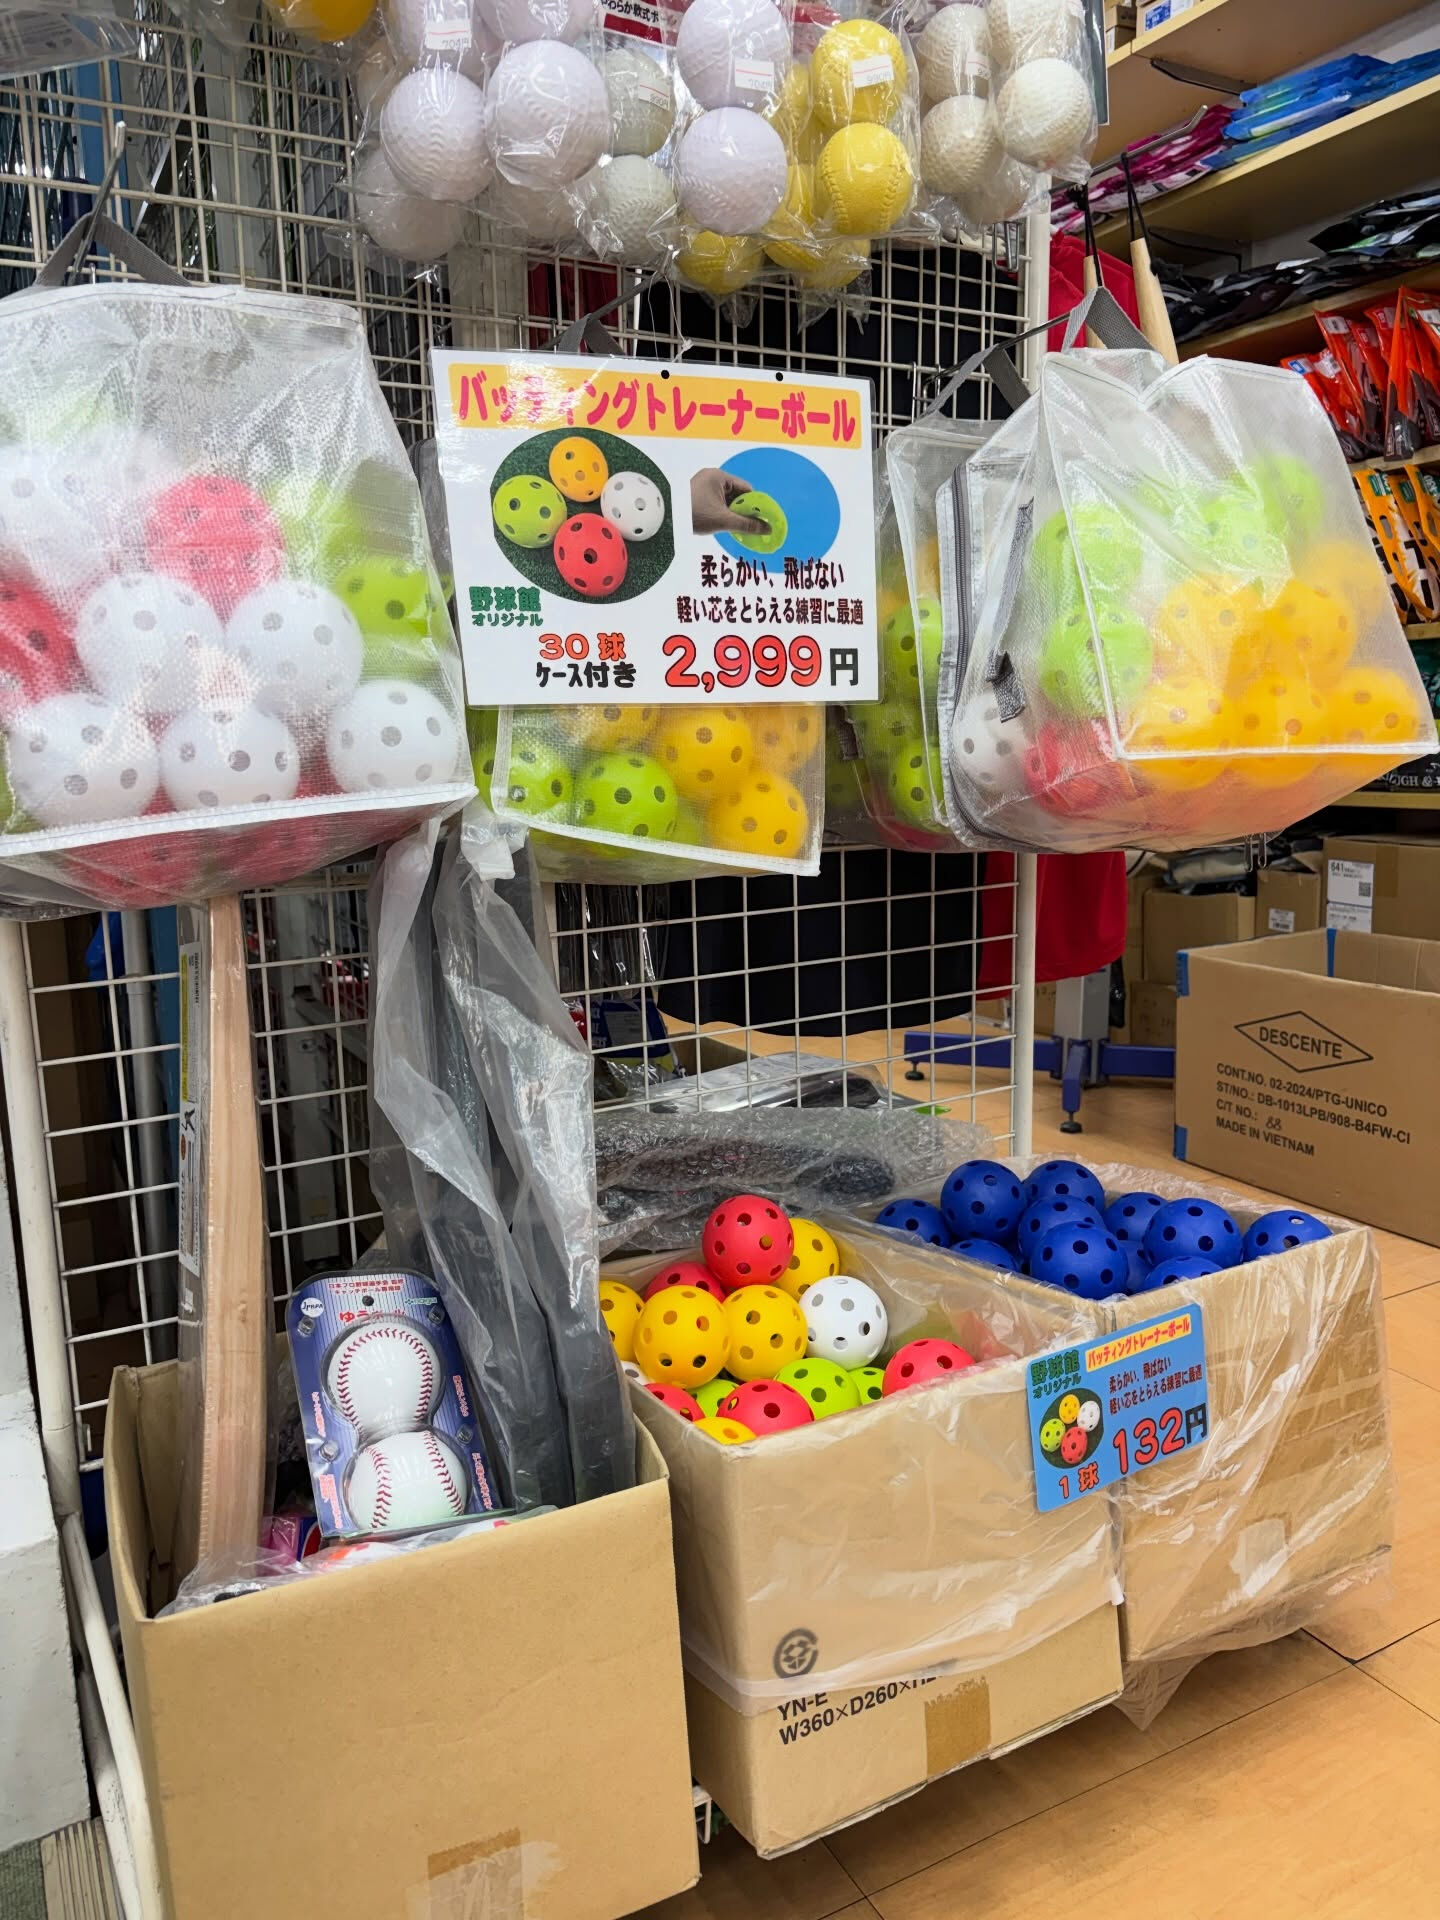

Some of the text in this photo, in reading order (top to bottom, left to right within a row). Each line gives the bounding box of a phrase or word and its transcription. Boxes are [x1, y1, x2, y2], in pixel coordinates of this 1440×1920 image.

[458, 370, 856, 443] バッティングトレーナーボール
[700, 554, 844, 591] 柔らかい、飛ばない
[469, 585, 543, 613] 野球館
[676, 595, 864, 626] 軽い芯をとらえる練習に最適
[471, 611, 544, 628] オリジナル
[535, 661, 637, 689] ケース付き
[1258, 1026, 1343, 1060] DESCENTE
[1269, 1075, 1388, 1119] 02-2024/PTG-UNICO
[1215, 1116, 1315, 1157] MADE IN VIETNAM
[1086, 1316, 1191, 1369] バッティングトレーナーボール
[1030, 1349, 1081, 1387] 野球館
[1032, 1373, 1082, 1400] オリジナル
[776, 1692, 828, 1721] YN-E
